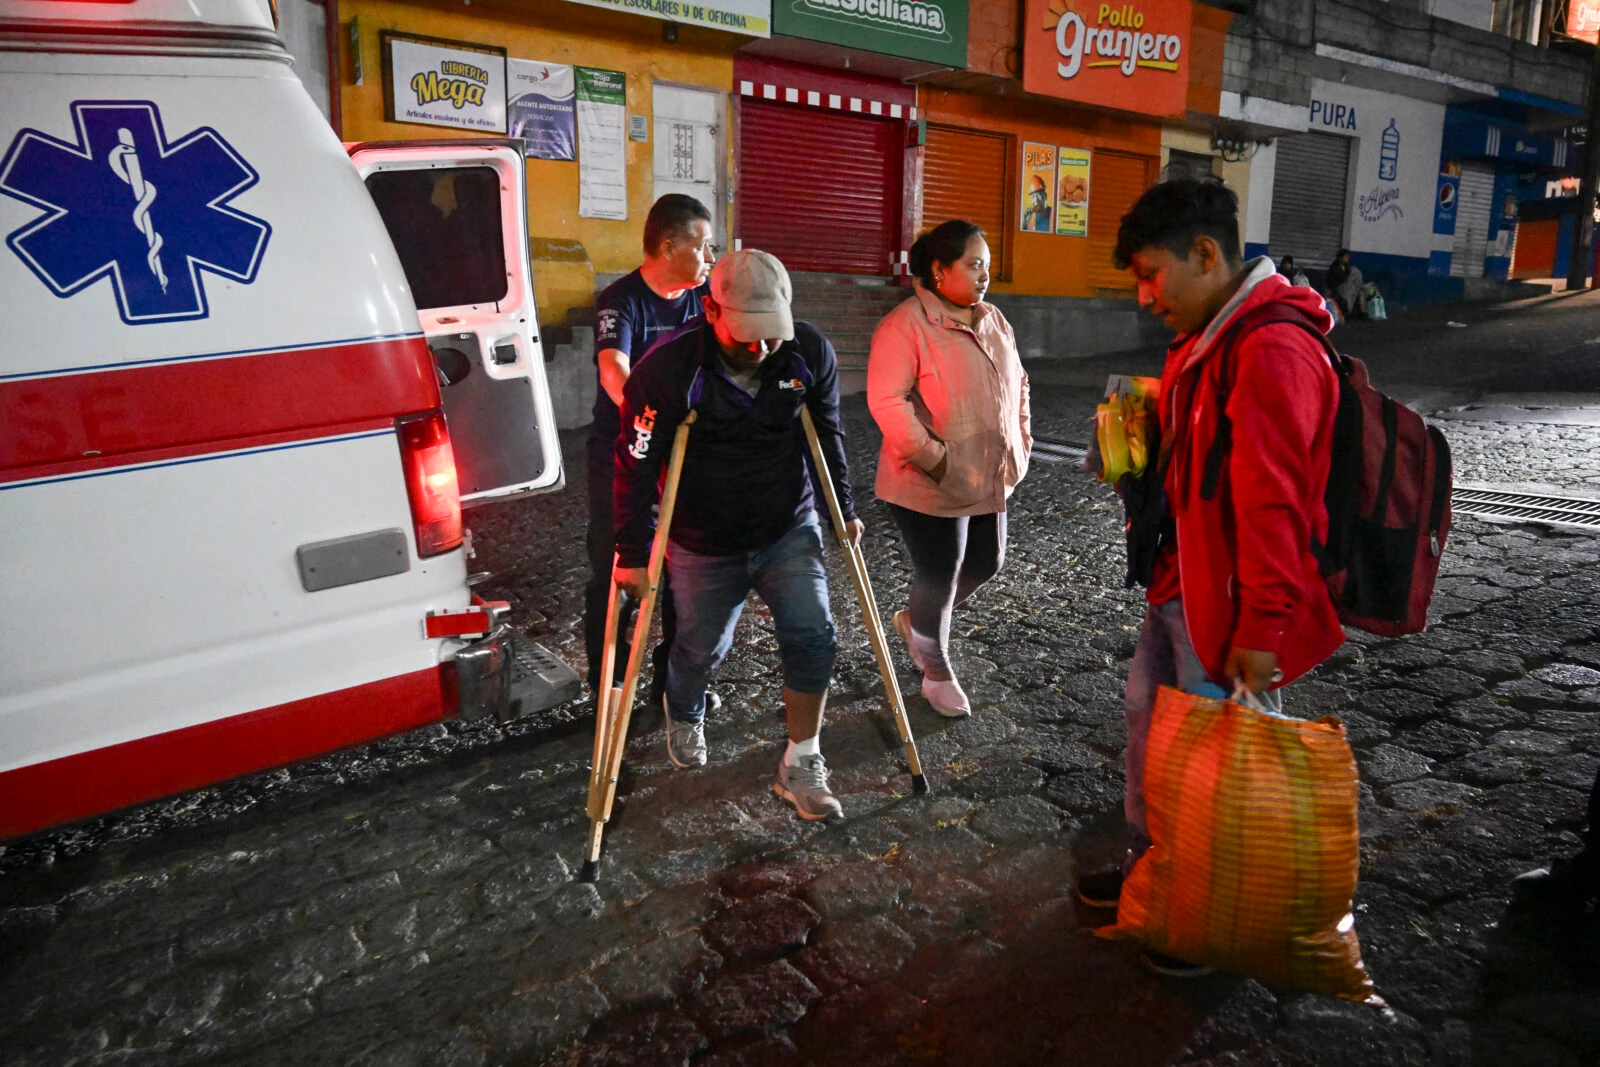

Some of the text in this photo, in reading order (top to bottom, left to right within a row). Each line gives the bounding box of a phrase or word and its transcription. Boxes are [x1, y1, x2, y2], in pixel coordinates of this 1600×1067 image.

[624, 0, 679, 15] ESCOLARES
[693, 7, 705, 20] DE
[708, 10, 746, 28] OFICINA
[806, 0, 942, 29] Siciliana
[1098, 4, 1144, 29] Pollo
[1056, 11, 1180, 78] granjero
[411, 71, 485, 109] Mega
[517, 73, 538, 84] cargo
[516, 101, 573, 113] AGENTE AUTORIZADO
[1310, 100, 1356, 131] PURA
[1025, 152, 1053, 167] PILAS
[778, 379, 803, 390] FedEx
[628, 403, 659, 460] FedEx
